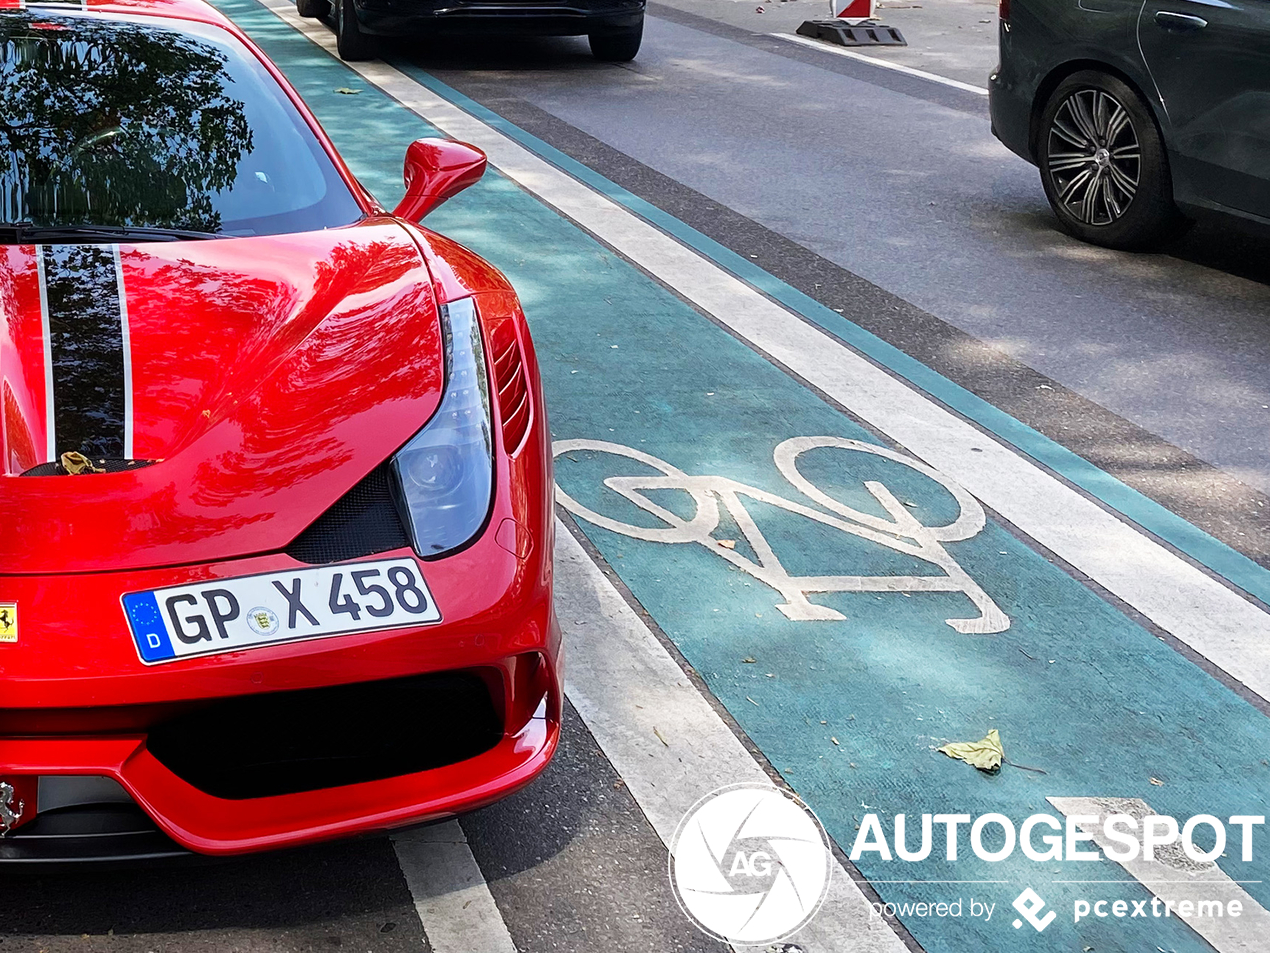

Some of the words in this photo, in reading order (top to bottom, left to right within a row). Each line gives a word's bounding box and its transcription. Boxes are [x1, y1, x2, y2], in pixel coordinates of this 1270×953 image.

[166, 588, 241, 645] GP
[271, 578, 321, 629] X
[329, 566, 428, 621] 458
[147, 633, 161, 648] D
